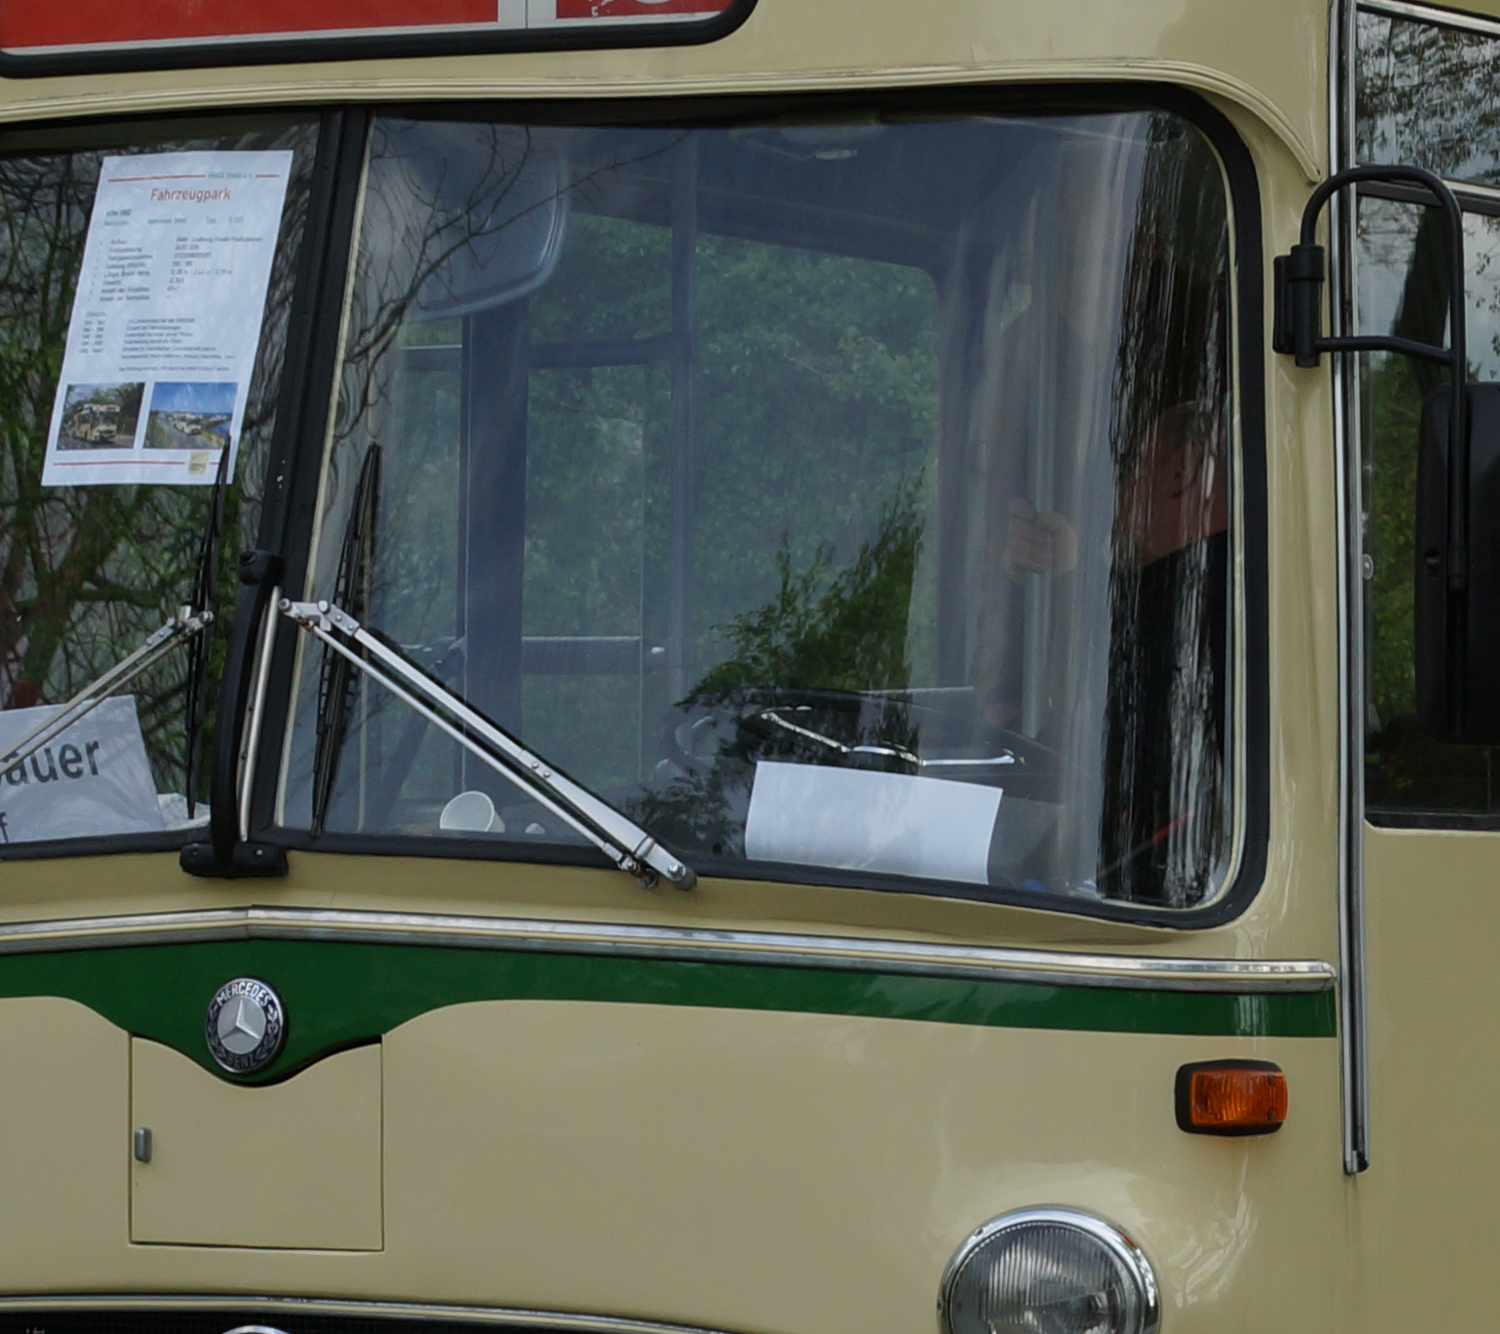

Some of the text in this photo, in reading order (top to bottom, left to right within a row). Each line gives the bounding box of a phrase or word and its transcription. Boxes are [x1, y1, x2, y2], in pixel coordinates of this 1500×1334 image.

[149, 186, 232, 204] Fahrzeugpark
[215, 981, 272, 1007] MERCEDES
[226, 1053, 257, 1069] BENZ
